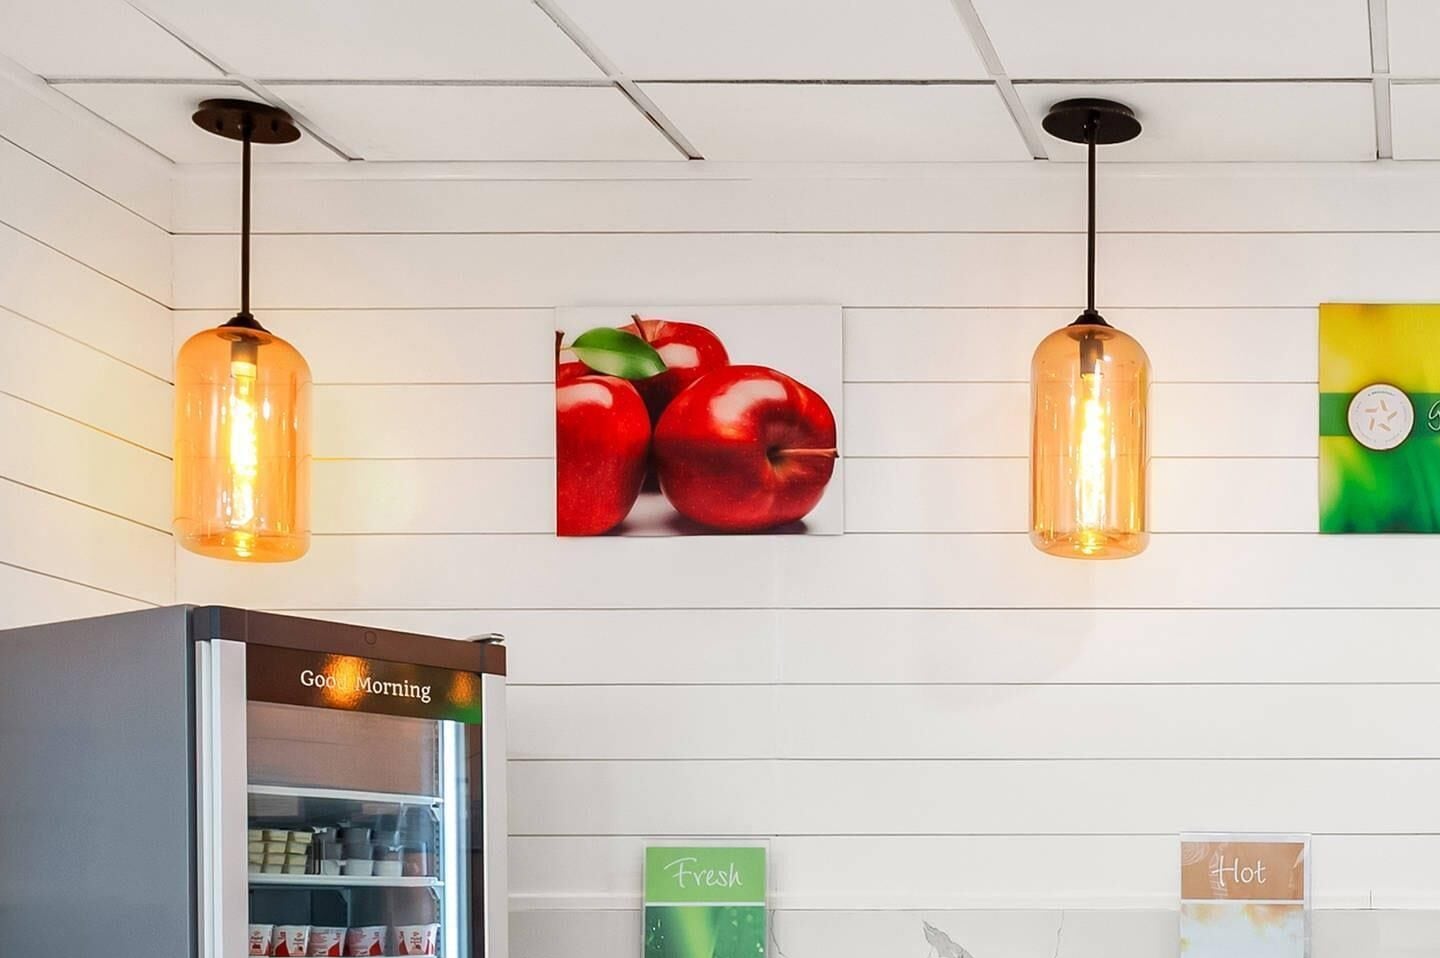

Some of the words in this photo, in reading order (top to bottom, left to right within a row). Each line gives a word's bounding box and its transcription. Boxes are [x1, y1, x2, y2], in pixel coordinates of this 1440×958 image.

[300, 669, 348, 690] Good
[354, 676, 432, 703] Morning
[663, 857, 744, 888] Fresh
[1211, 855, 1266, 887] Hot
